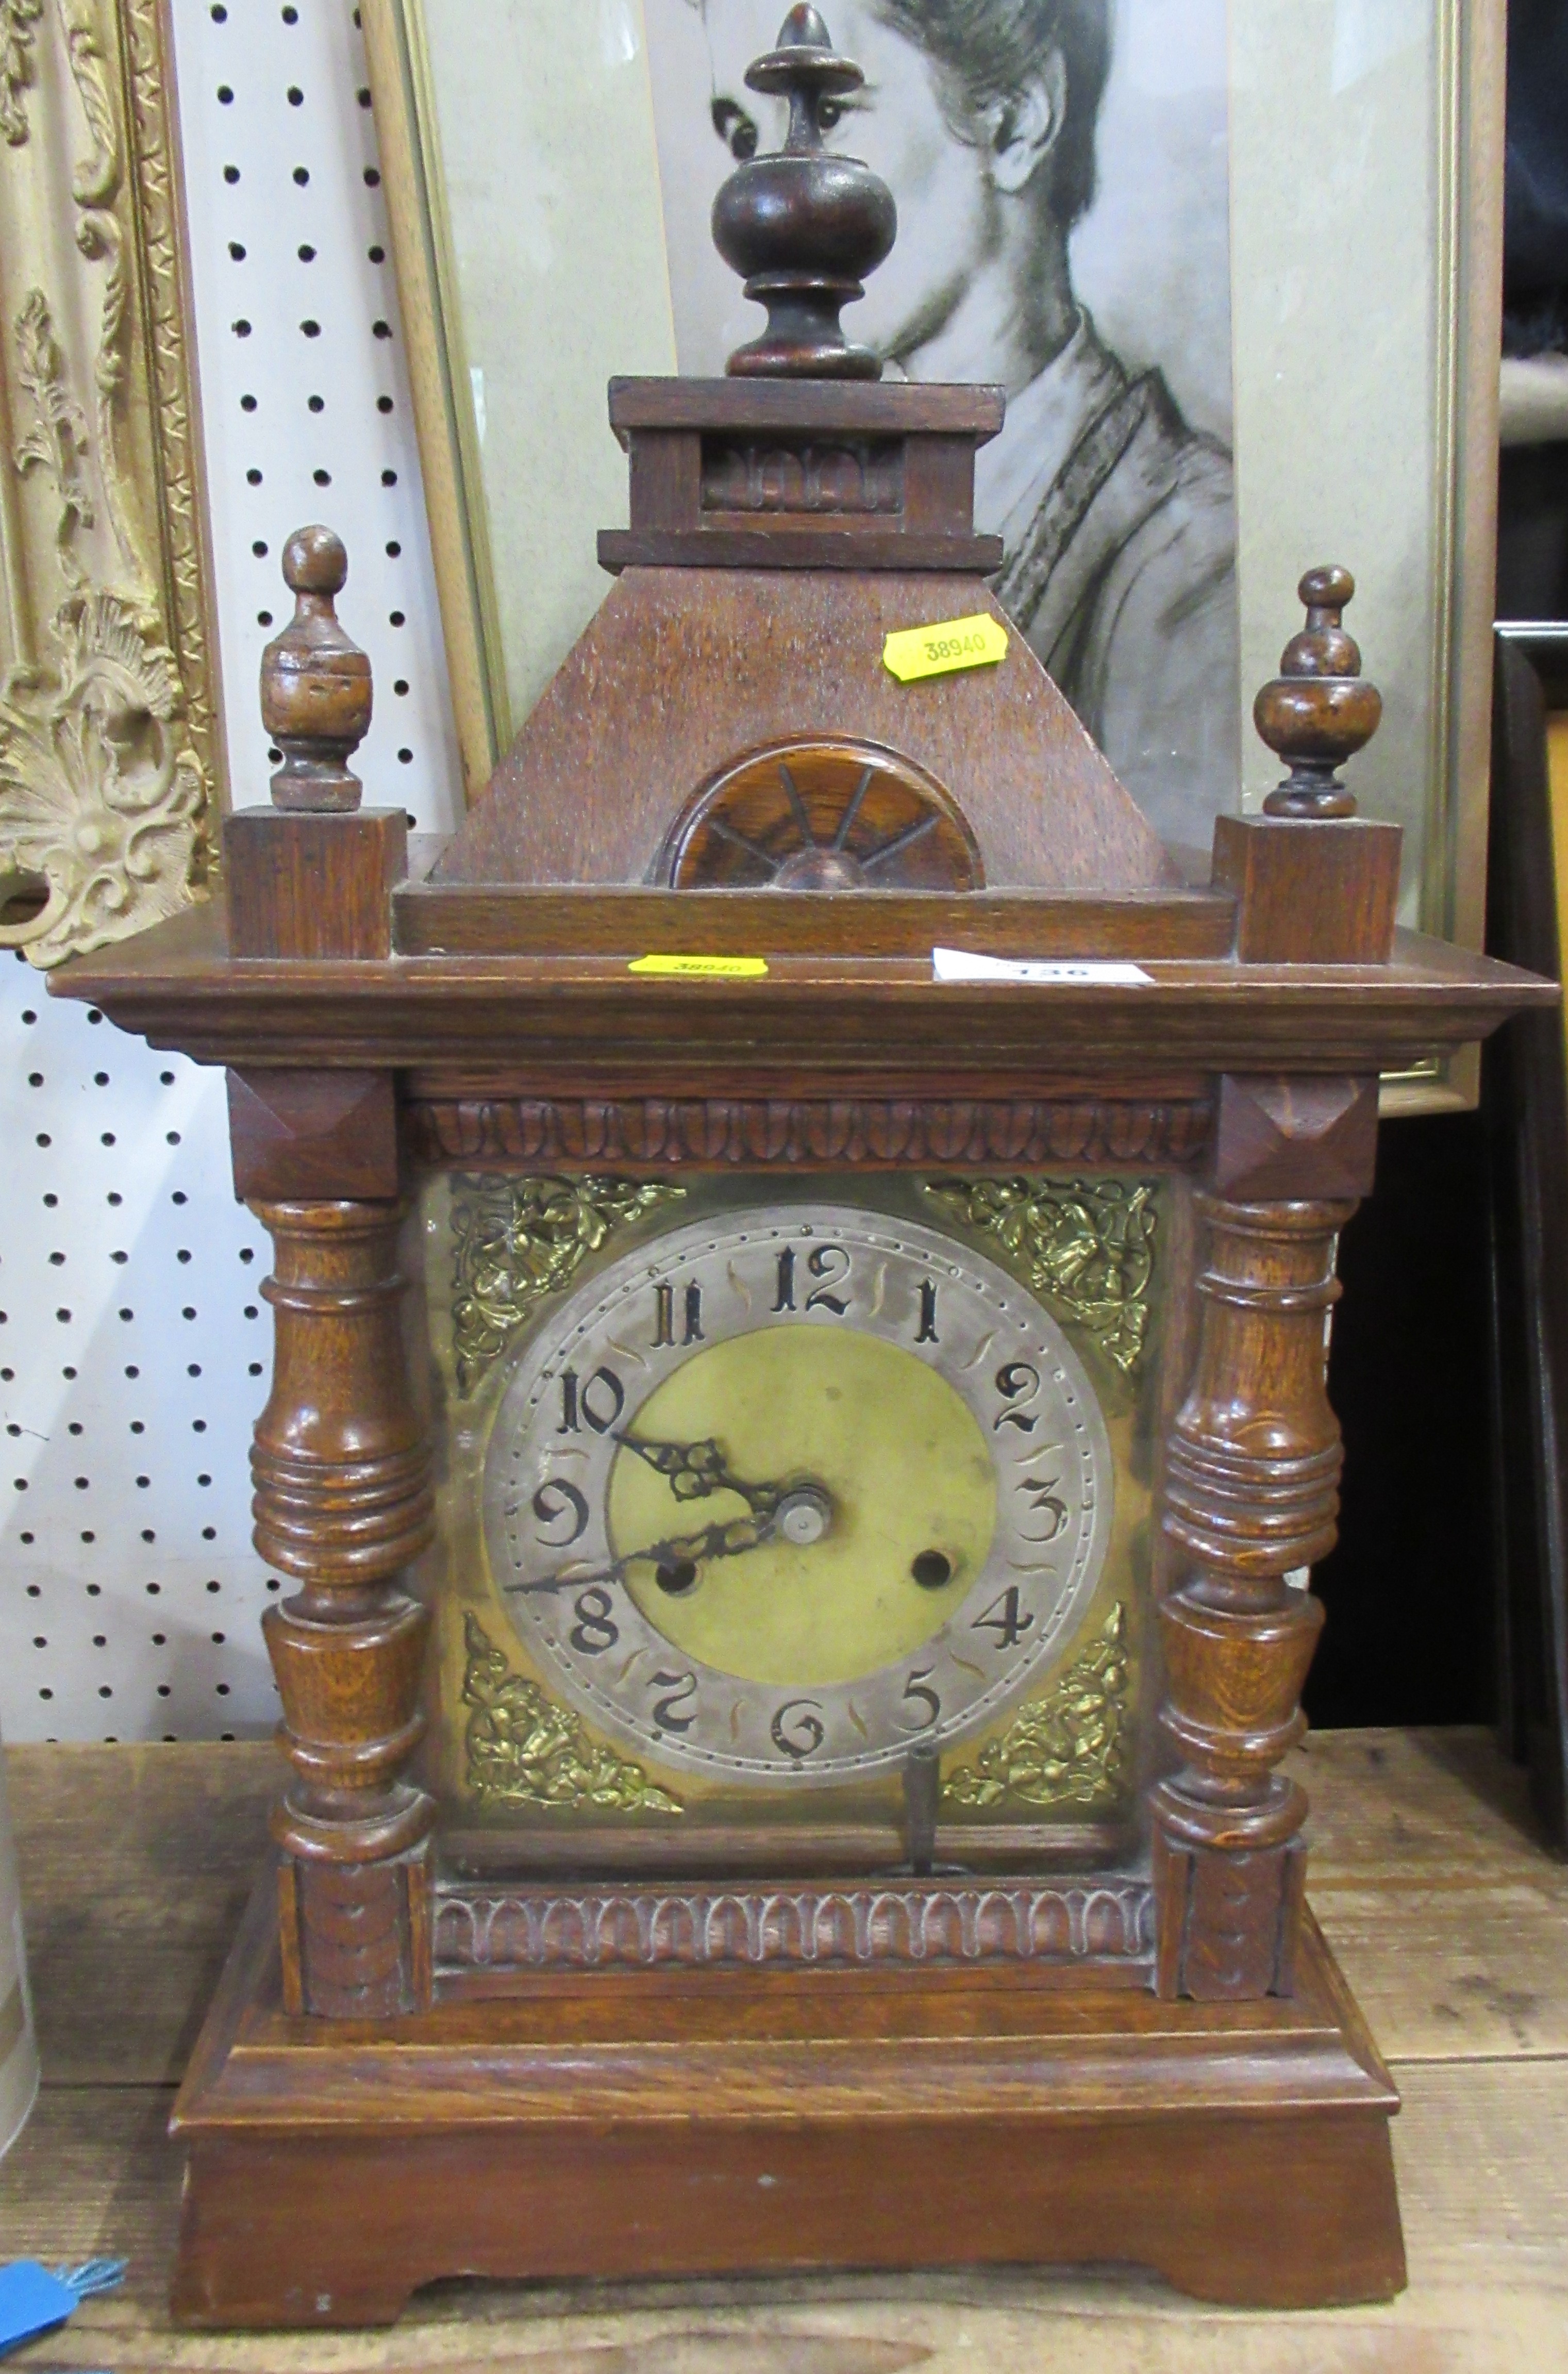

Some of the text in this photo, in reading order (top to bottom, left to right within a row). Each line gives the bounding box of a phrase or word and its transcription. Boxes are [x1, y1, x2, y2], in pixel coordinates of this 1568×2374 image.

[924, 634, 986, 661] 38940
[673, 962, 742, 972] 38940
[649, 1277, 705, 1348] 11
[770, 1244, 852, 1316] 12
[914, 1275, 941, 1343] 1
[556, 1366, 625, 1435] 10
[993, 1362, 1040, 1433] 2
[533, 1477, 589, 1547] 9
[1013, 1477, 1069, 1543] 3
[571, 1587, 619, 1655] 8
[970, 1586, 1034, 1650] 4
[646, 1671, 698, 1733] 7
[772, 1699, 824, 1759] 6
[894, 1665, 941, 1732] 5
